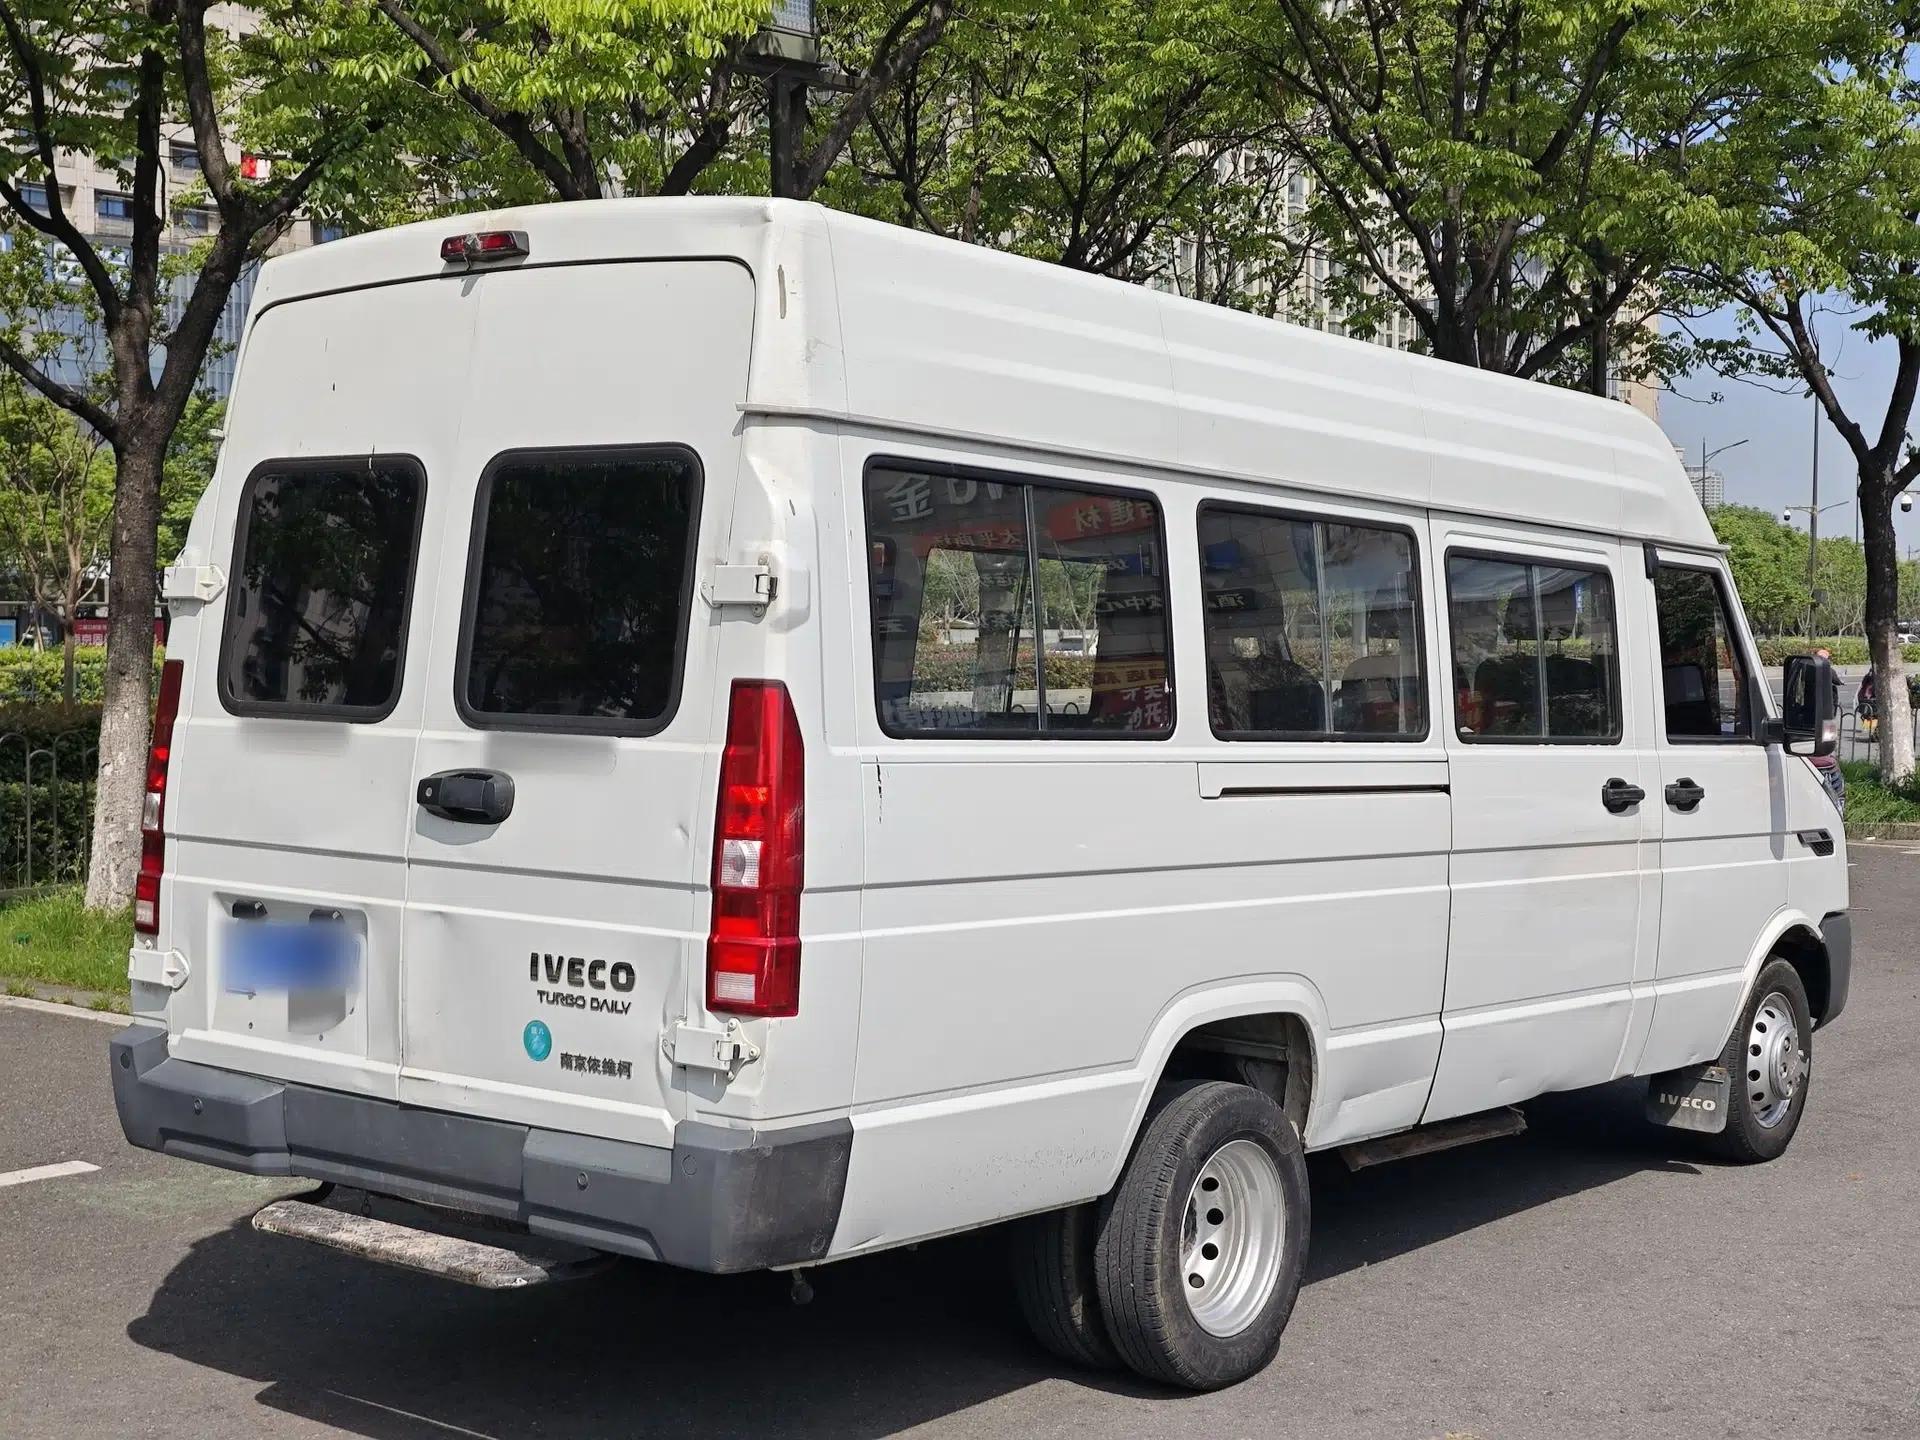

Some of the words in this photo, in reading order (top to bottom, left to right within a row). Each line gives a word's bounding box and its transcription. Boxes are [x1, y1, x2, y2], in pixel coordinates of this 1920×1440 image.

[530, 952, 636, 993] IVECO
[537, 990, 586, 1010] TURBO
[590, 997, 632, 1015] DAILY
[560, 1052, 633, 1080] 南京依维柯
[1660, 1093, 1716, 1111] IVECO
